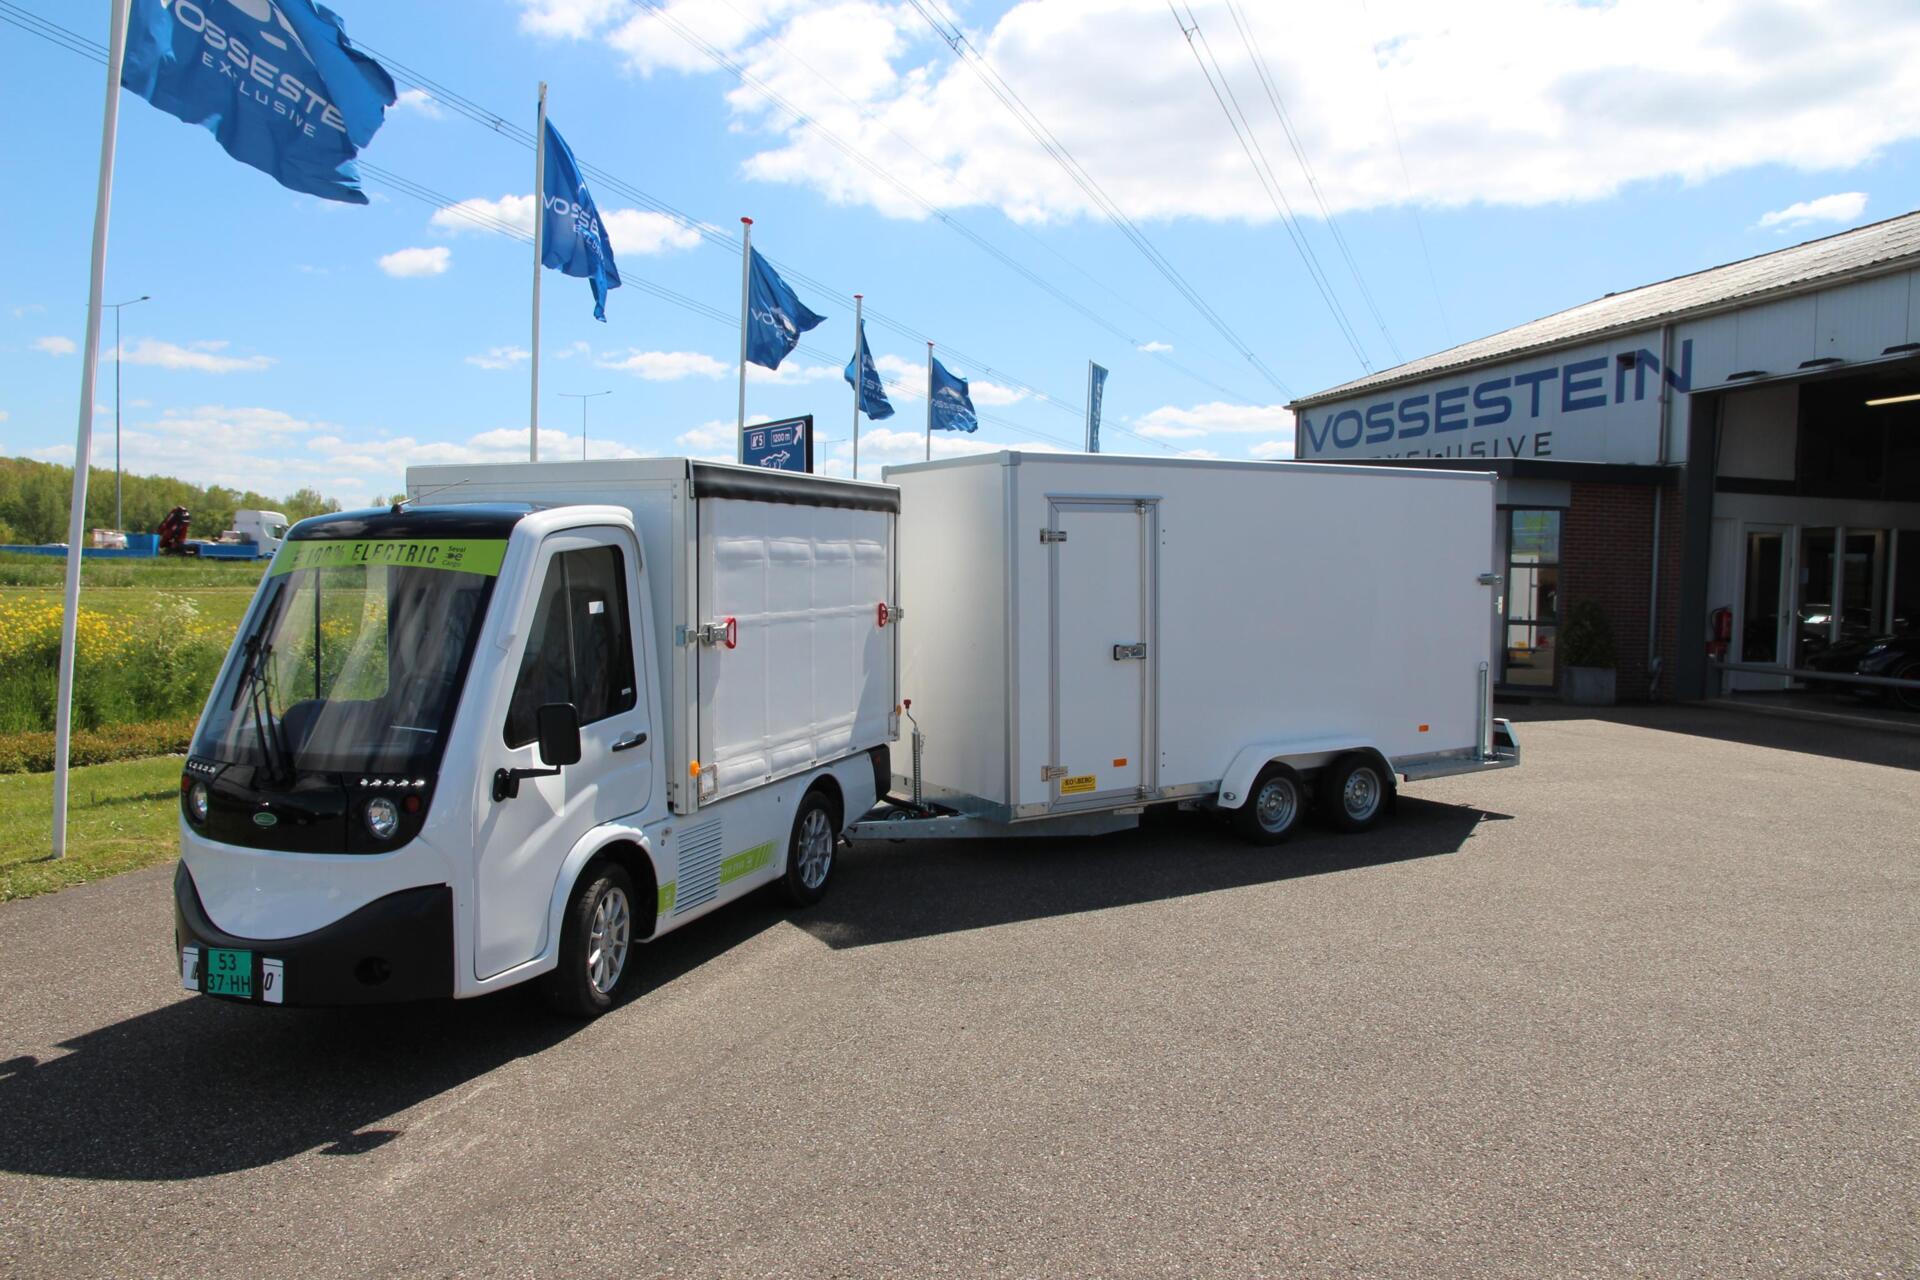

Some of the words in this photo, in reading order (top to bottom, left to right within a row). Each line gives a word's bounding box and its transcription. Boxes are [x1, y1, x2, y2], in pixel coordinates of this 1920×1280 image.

[174, 0, 347, 133] OSSESTE
[1303, 339, 1693, 454] VOSSESTEIN
[352, 543, 440, 564] ELECTRIC
[218, 953, 237, 971] 53
